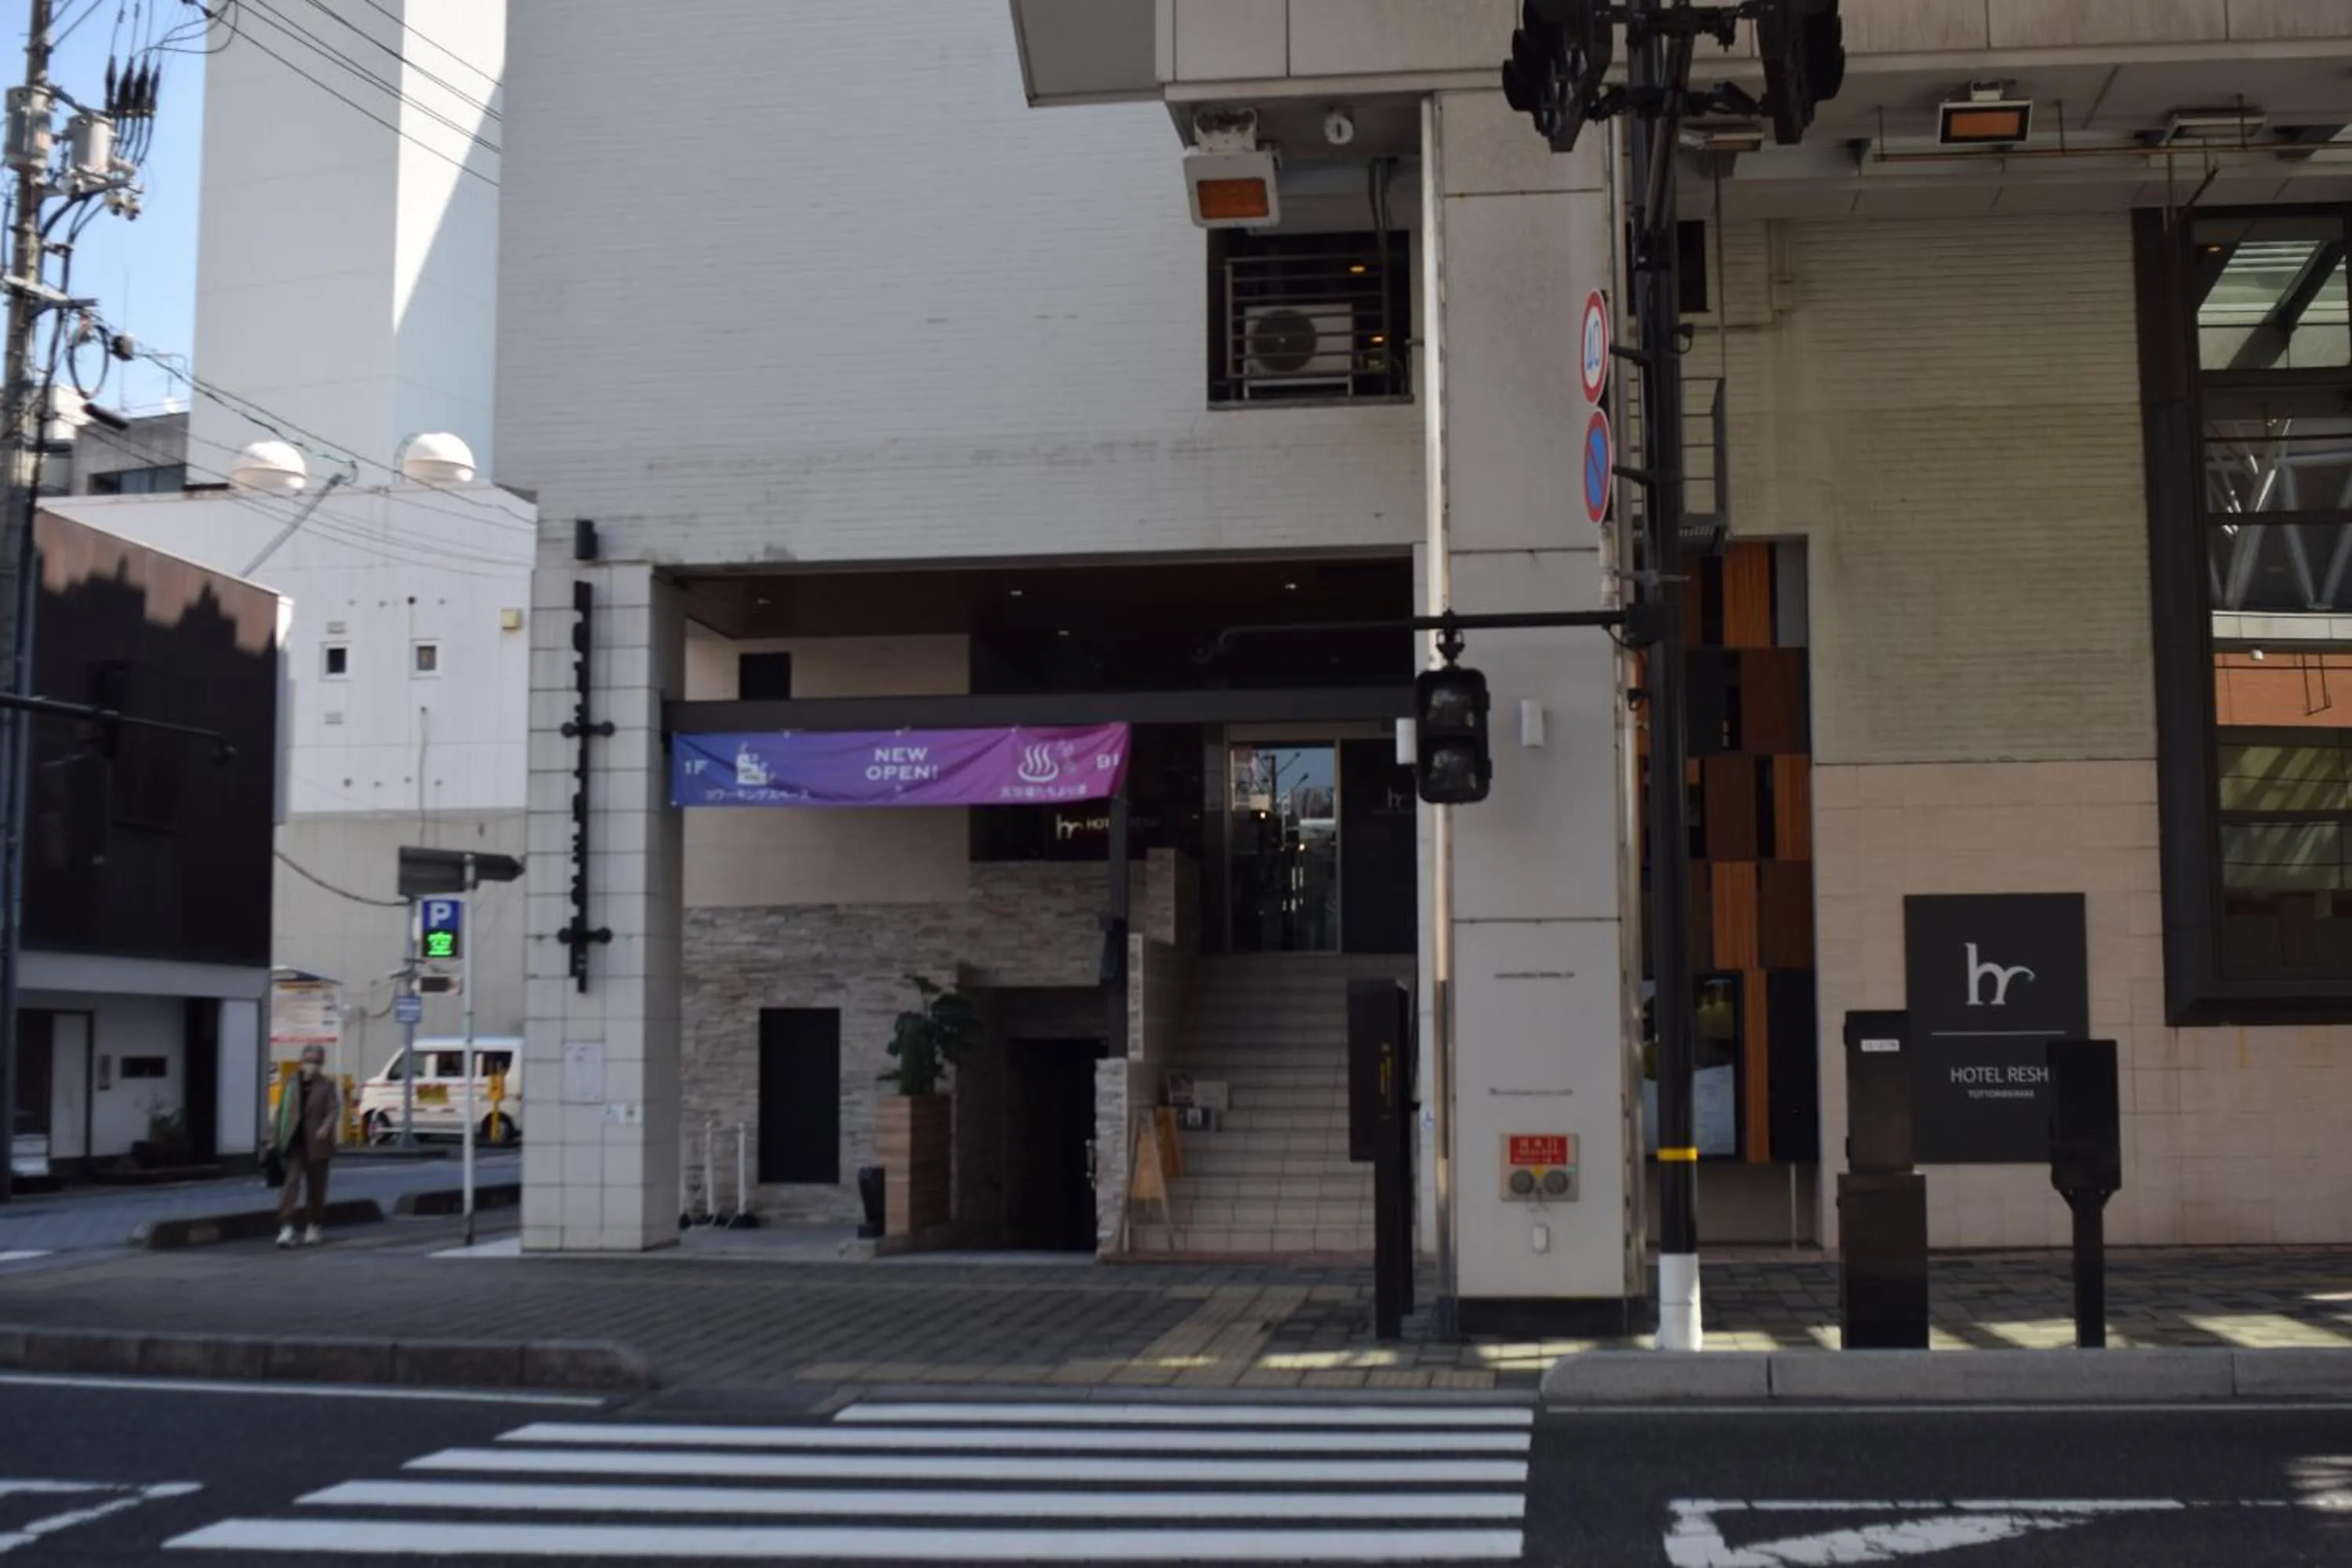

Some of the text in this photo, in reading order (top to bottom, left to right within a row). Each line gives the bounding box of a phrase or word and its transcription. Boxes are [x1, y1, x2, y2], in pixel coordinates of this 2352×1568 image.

[874, 746, 928, 763] NEW
[866, 764, 938, 781] OPEN!
[430, 902, 452, 928] P
[1951, 1065, 2049, 1083] HOTEL RESH
